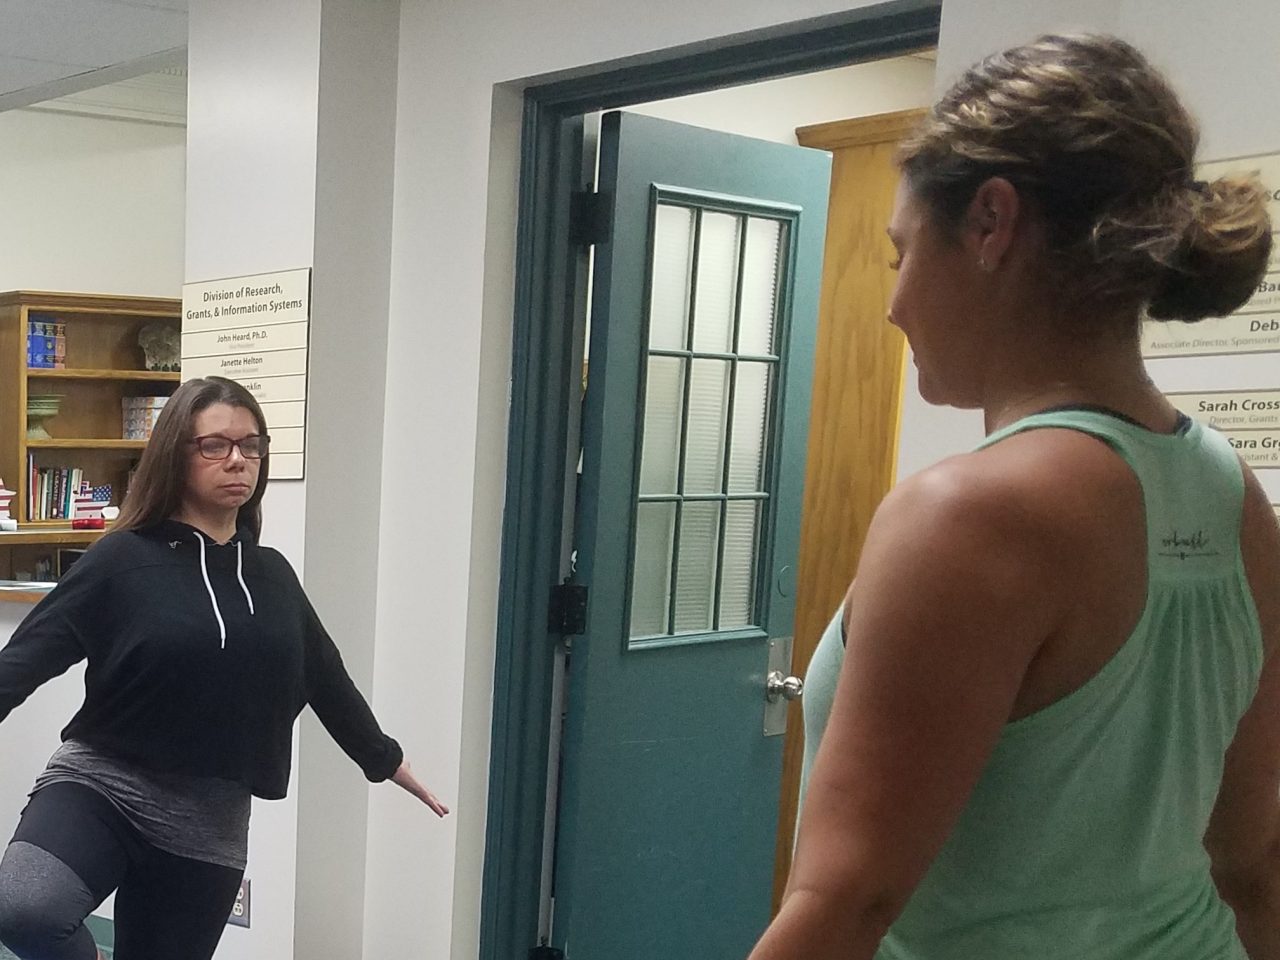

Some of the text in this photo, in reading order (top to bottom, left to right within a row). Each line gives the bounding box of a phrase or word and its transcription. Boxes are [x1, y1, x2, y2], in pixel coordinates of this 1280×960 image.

[203, 283, 283, 303] Division of Research,
[186, 299, 303, 320] Grants, & Information Systems
[217, 333, 231, 343] John
[252, 330, 268, 339] Ph.D.
[1198, 399, 1238, 412] Sarah
